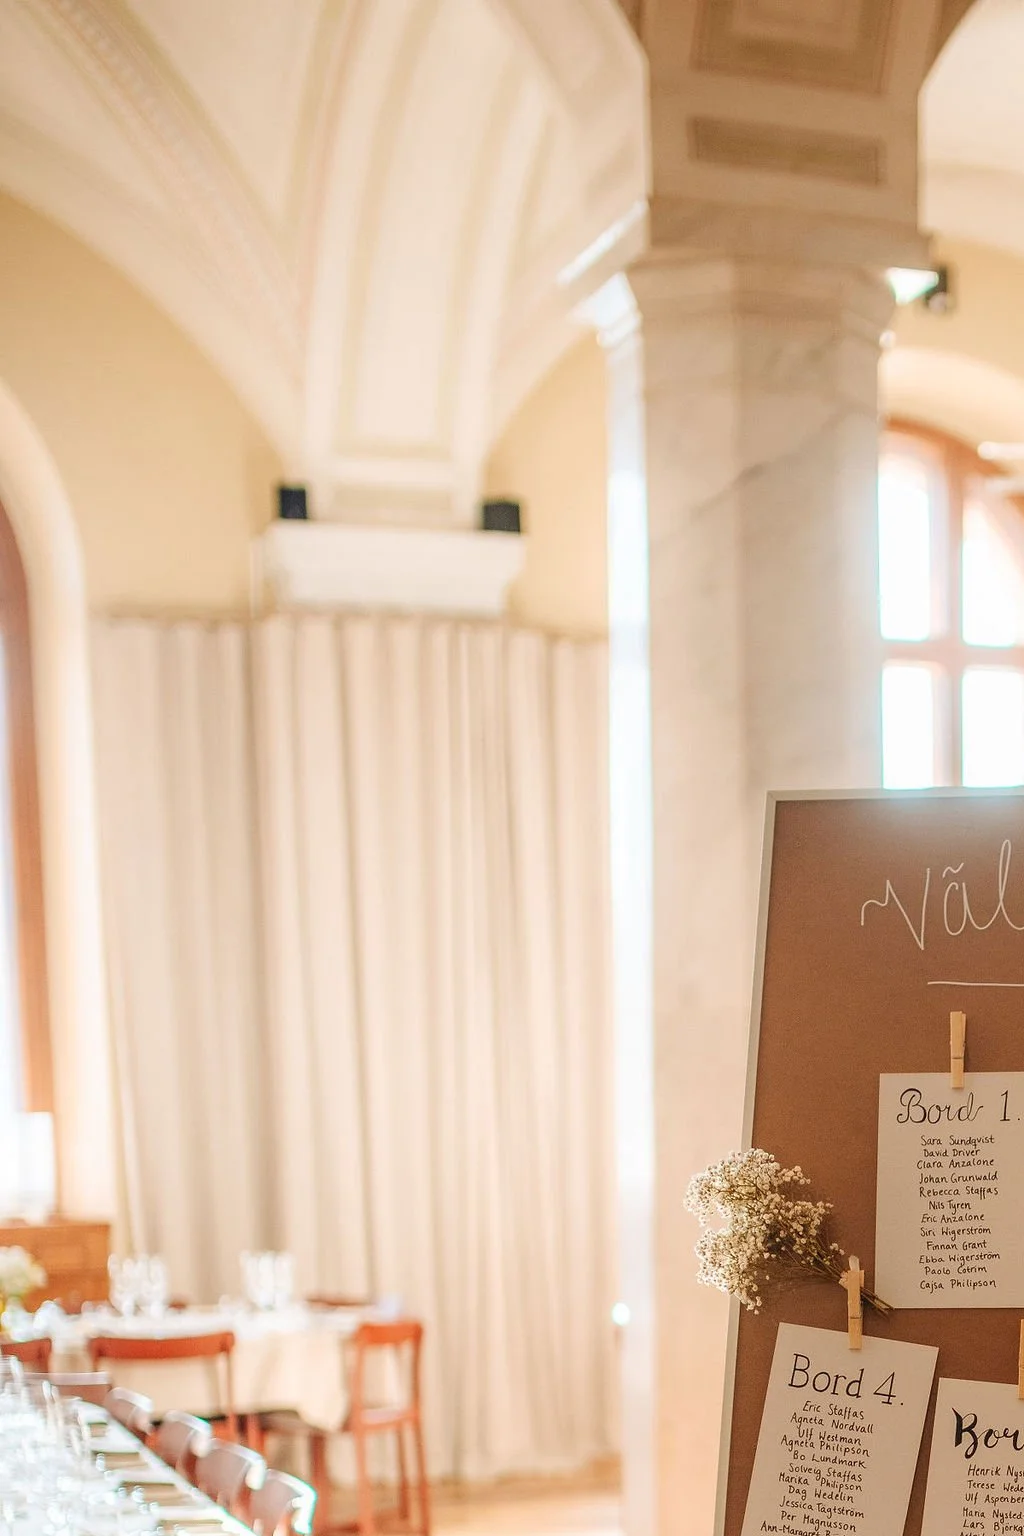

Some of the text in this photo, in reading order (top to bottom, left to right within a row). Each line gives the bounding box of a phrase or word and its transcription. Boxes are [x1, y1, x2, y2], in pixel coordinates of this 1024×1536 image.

[896, 1087, 1020, 1124] Bord 1.
[920, 1134, 995, 1149] Sara Sundqvist
[923, 1148, 981, 1158] David Driver
[916, 1158, 994, 1170] Clara Anzalone
[919, 1170, 998, 1185] Johan Grunwald
[929, 1199, 972, 1215] Nils Tyren
[920, 1279, 997, 1294] Cajsa Philipson
[788, 1353, 904, 1406] Bord 4.
[802, 1400, 864, 1420] Eric Staffas
[790, 1412, 874, 1434] Agneta Nordvall
[796, 1428, 861, 1446] Ulf Westman
[793, 1450, 867, 1469] Bo Lundmark
[967, 1463, 1001, 1476] Henrik
[967, 1479, 995, 1490] Terese
[788, 1485, 854, 1504] Dag Wedelin
[965, 1492, 979, 1505] Ulf
[781, 1510, 856, 1533] Per Magnusson
[962, 1518, 985, 1530] Lars
